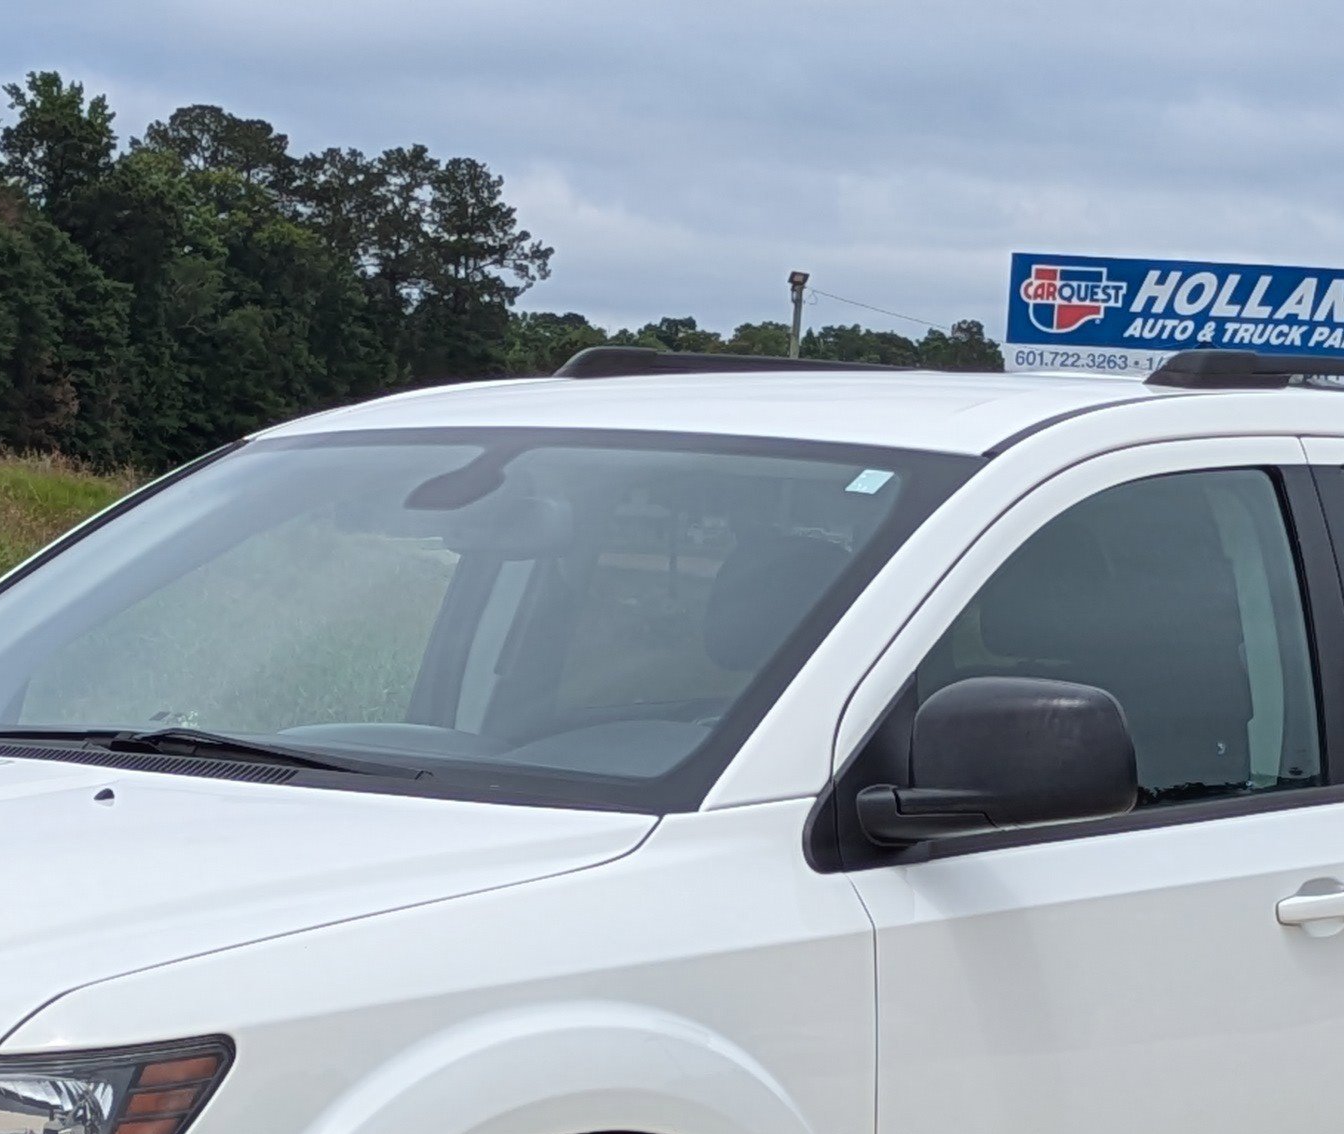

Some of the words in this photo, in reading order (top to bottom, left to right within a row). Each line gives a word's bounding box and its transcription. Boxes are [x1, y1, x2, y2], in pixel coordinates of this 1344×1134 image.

[1023, 281, 1124, 305] CARQUEST
[1123, 317, 1195, 341] AUTO
[1197, 321, 1217, 343] &
[1222, 322, 1309, 347] TRUCK
[1015, 350, 1128, 371] 601.722.3263
